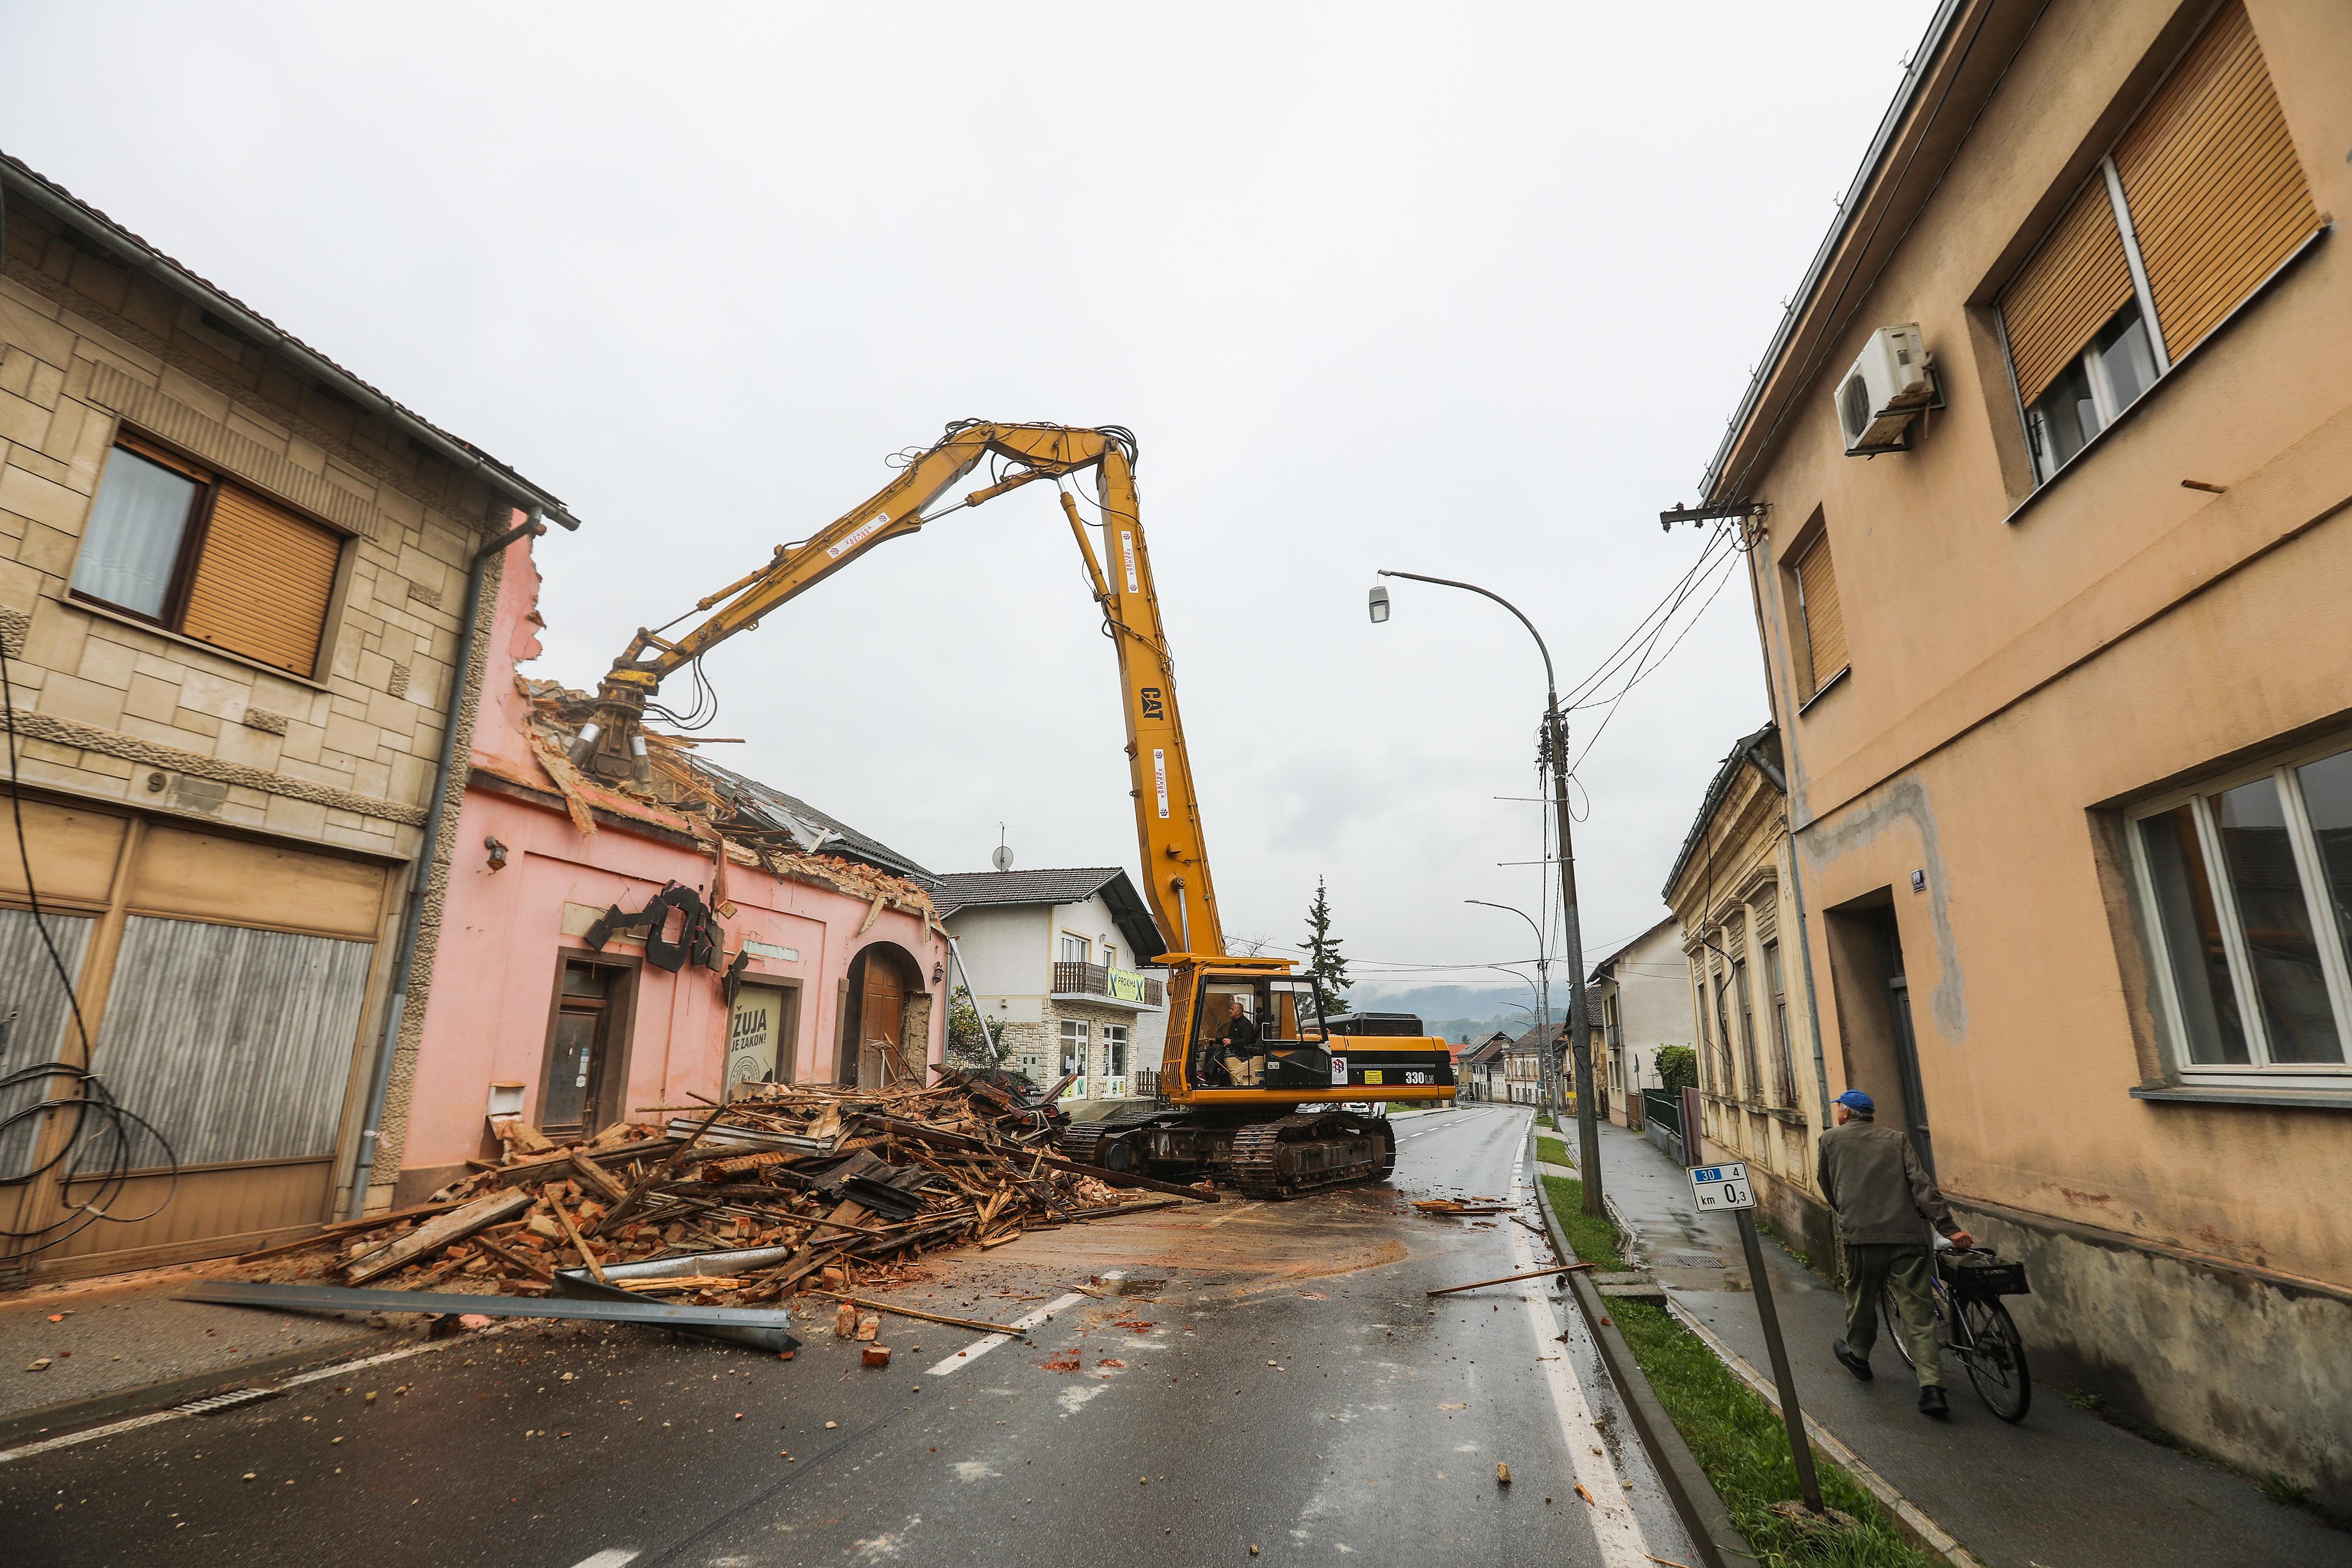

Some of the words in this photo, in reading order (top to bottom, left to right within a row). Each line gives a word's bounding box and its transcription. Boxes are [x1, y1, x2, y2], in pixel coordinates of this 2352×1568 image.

[851, 530, 870, 544] OSIJEK
[1141, 687, 1164, 721] CAT
[147, 771, 166, 792] 9
[1913, 871, 1920, 884] 10
[1118, 977, 1135, 988] PROXIMA
[732, 1005, 767, 1038] ŽUJA
[731, 1039, 739, 1052] JE
[740, 1033, 767, 1050] ZAKON!
[734, 1059, 753, 1073] CROATIAN
[1702, 1170, 1715, 1181] 30
[1733, 1167, 1739, 1176] 4
[1700, 1195, 1716, 1205] km
[1724, 1183, 1746, 1204] 0,3
